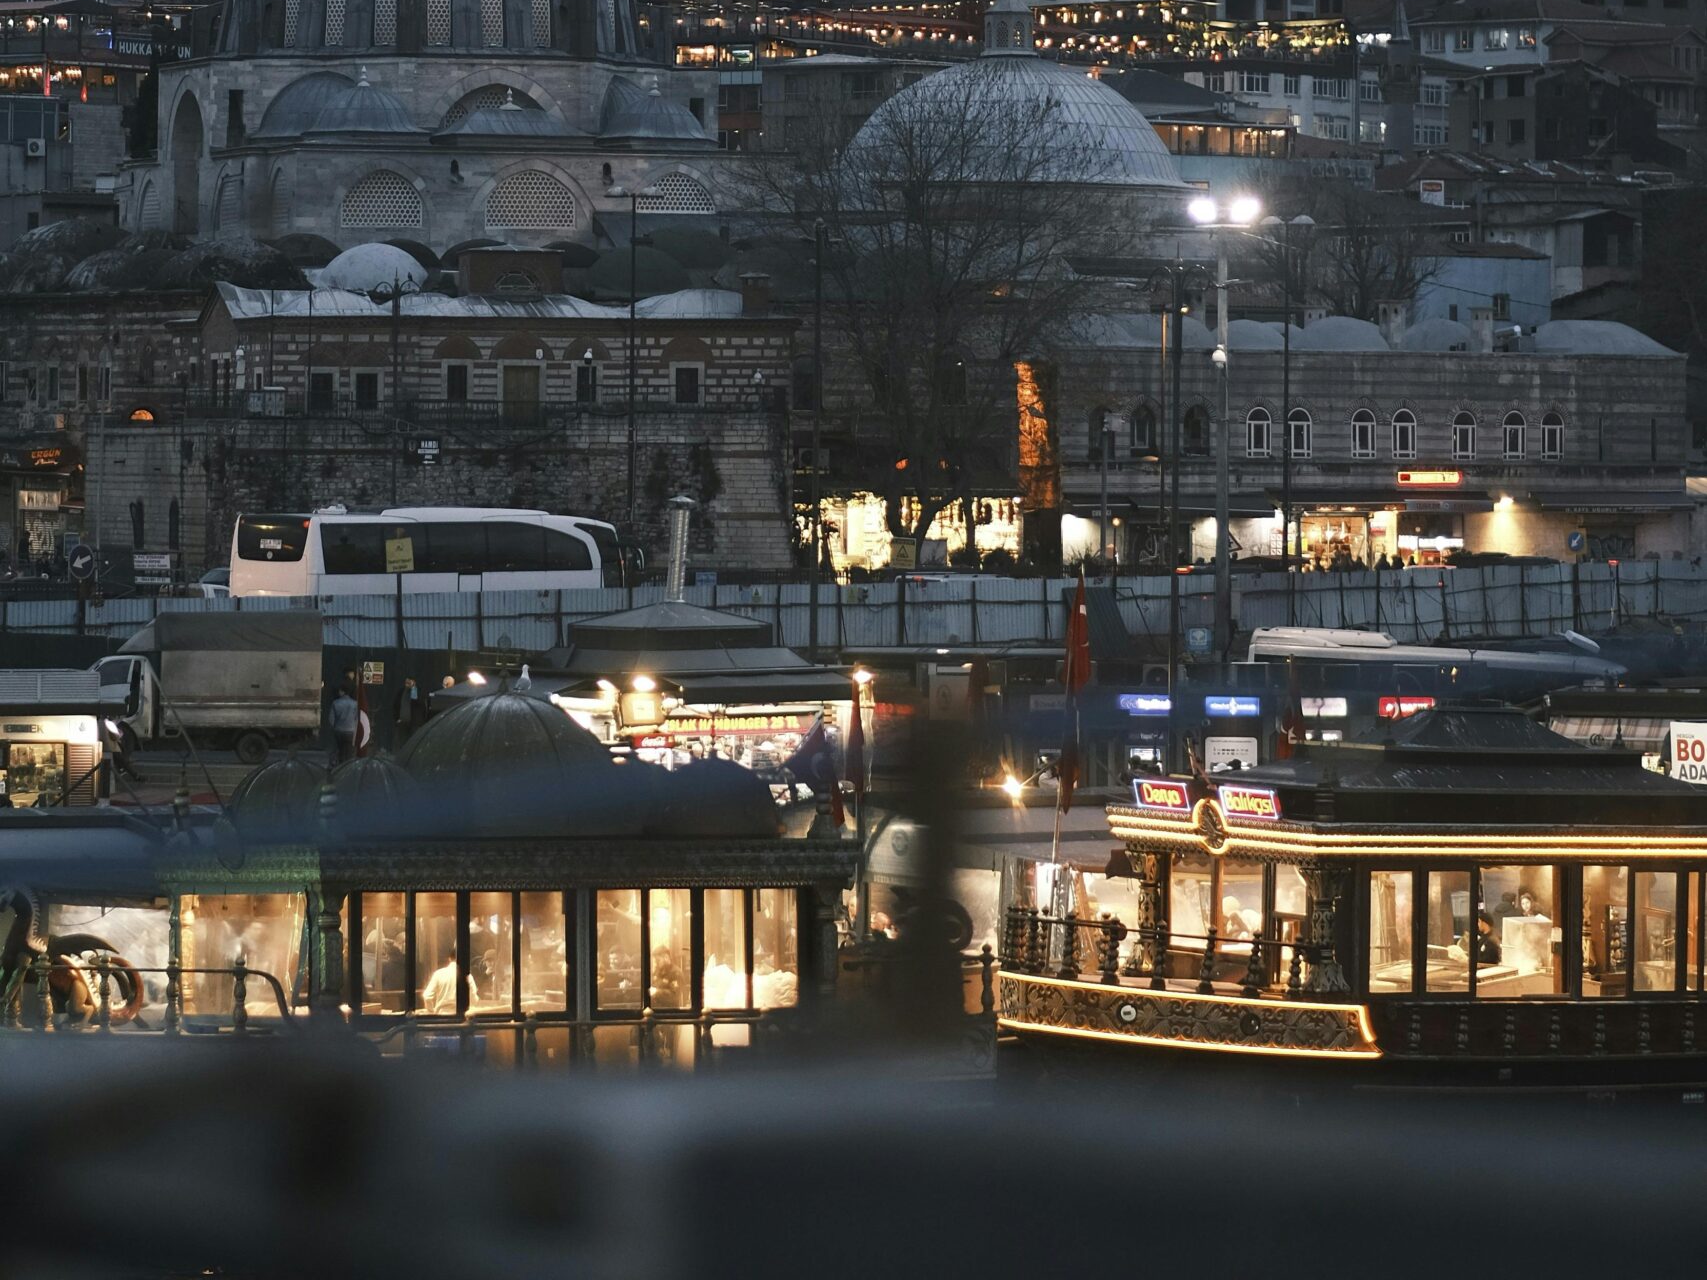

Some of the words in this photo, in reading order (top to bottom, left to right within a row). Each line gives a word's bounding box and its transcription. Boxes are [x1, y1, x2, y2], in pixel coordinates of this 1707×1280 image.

[118, 41, 153, 56] HUKKA
[699, 717, 769, 731] HAMBURGER
[1143, 783, 1181, 807] Derya
